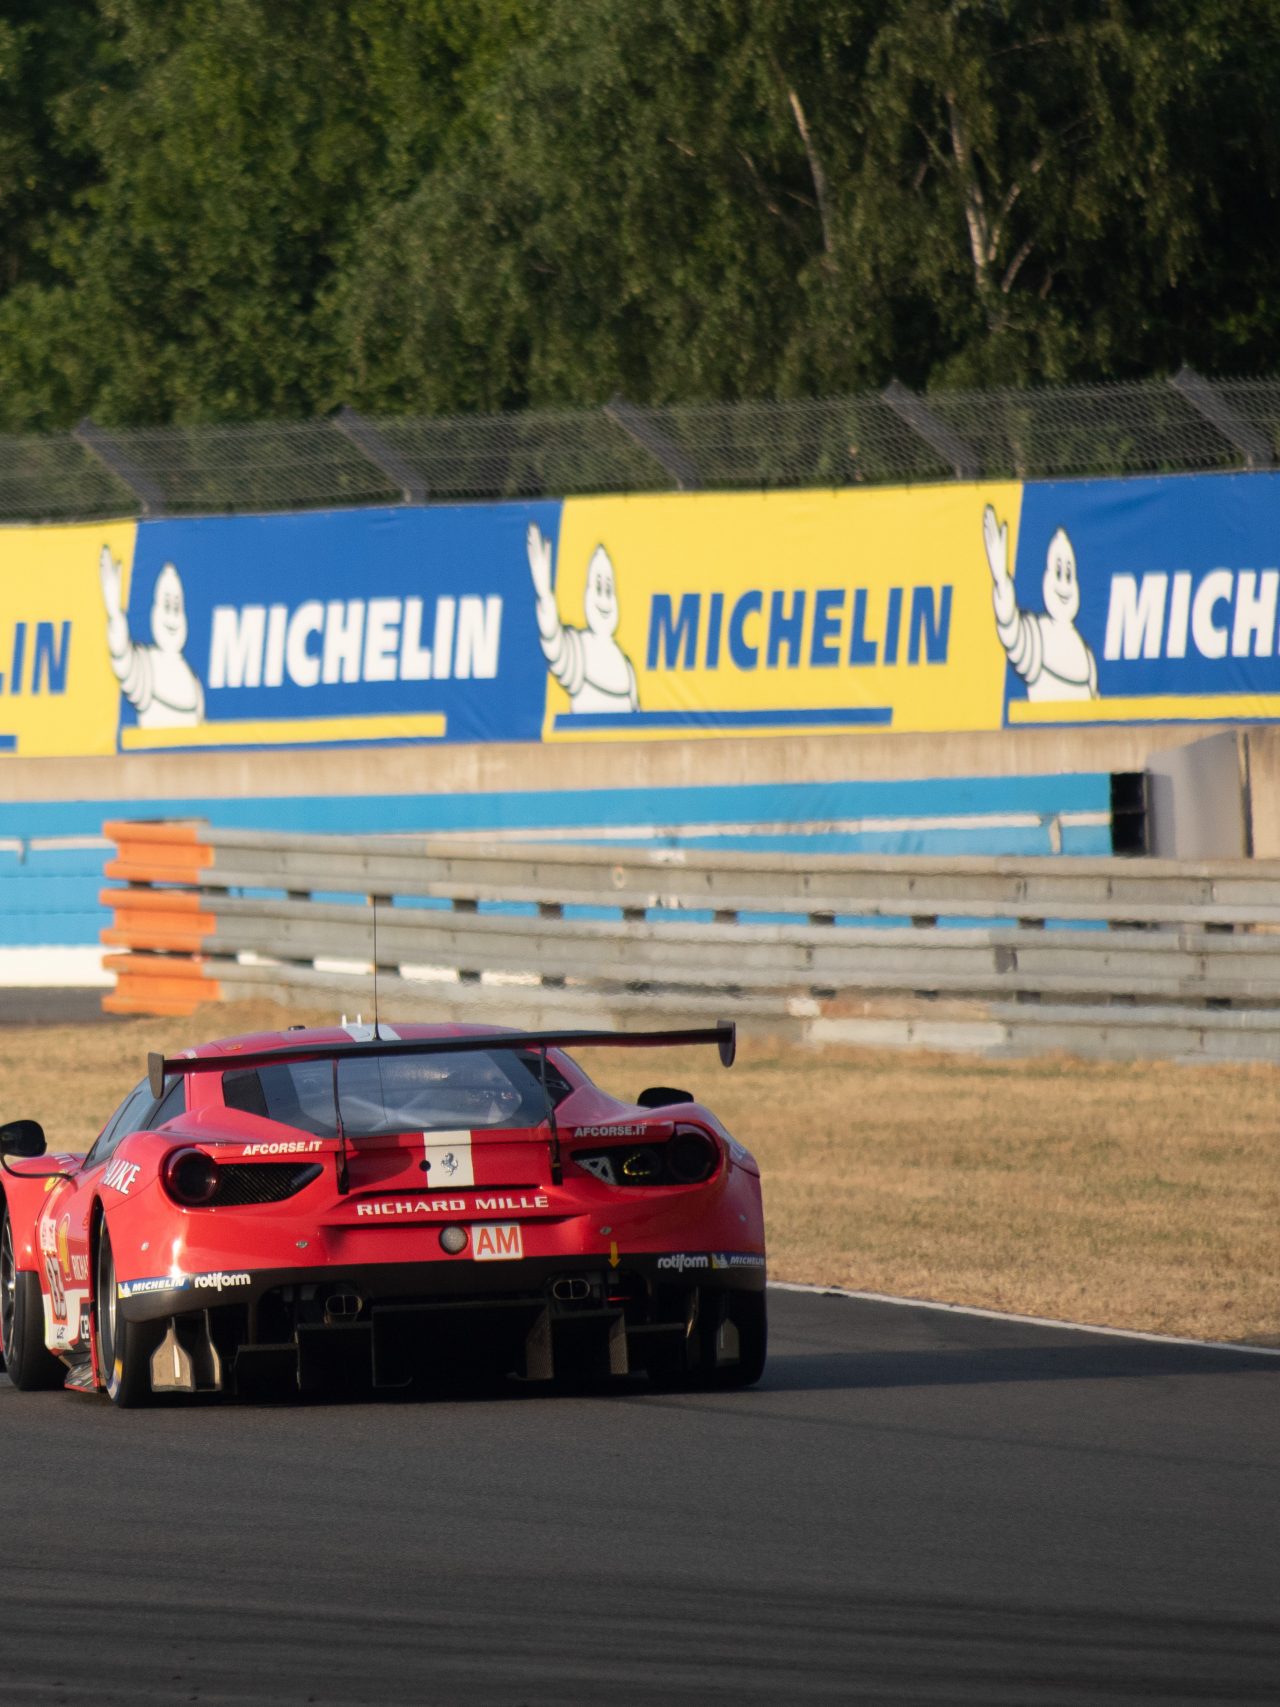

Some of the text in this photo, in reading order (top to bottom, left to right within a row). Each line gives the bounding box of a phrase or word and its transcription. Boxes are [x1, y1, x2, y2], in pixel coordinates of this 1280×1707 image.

[1104, 569, 1280, 661] MICH
[648, 586, 952, 669] MICHELIN
[209, 595, 502, 690] MICHELIN
[574, 1125, 648, 1138] AFCORSE.IT
[242, 1141, 323, 1156] AFCORSE.IT
[357, 1196, 550, 1216] RICHARD MILLE
[477, 1226, 521, 1256] AM
[657, 1254, 708, 1273] rotiform
[131, 1277, 186, 1293] MICHELIN
[194, 1272, 252, 1292] rotiform
